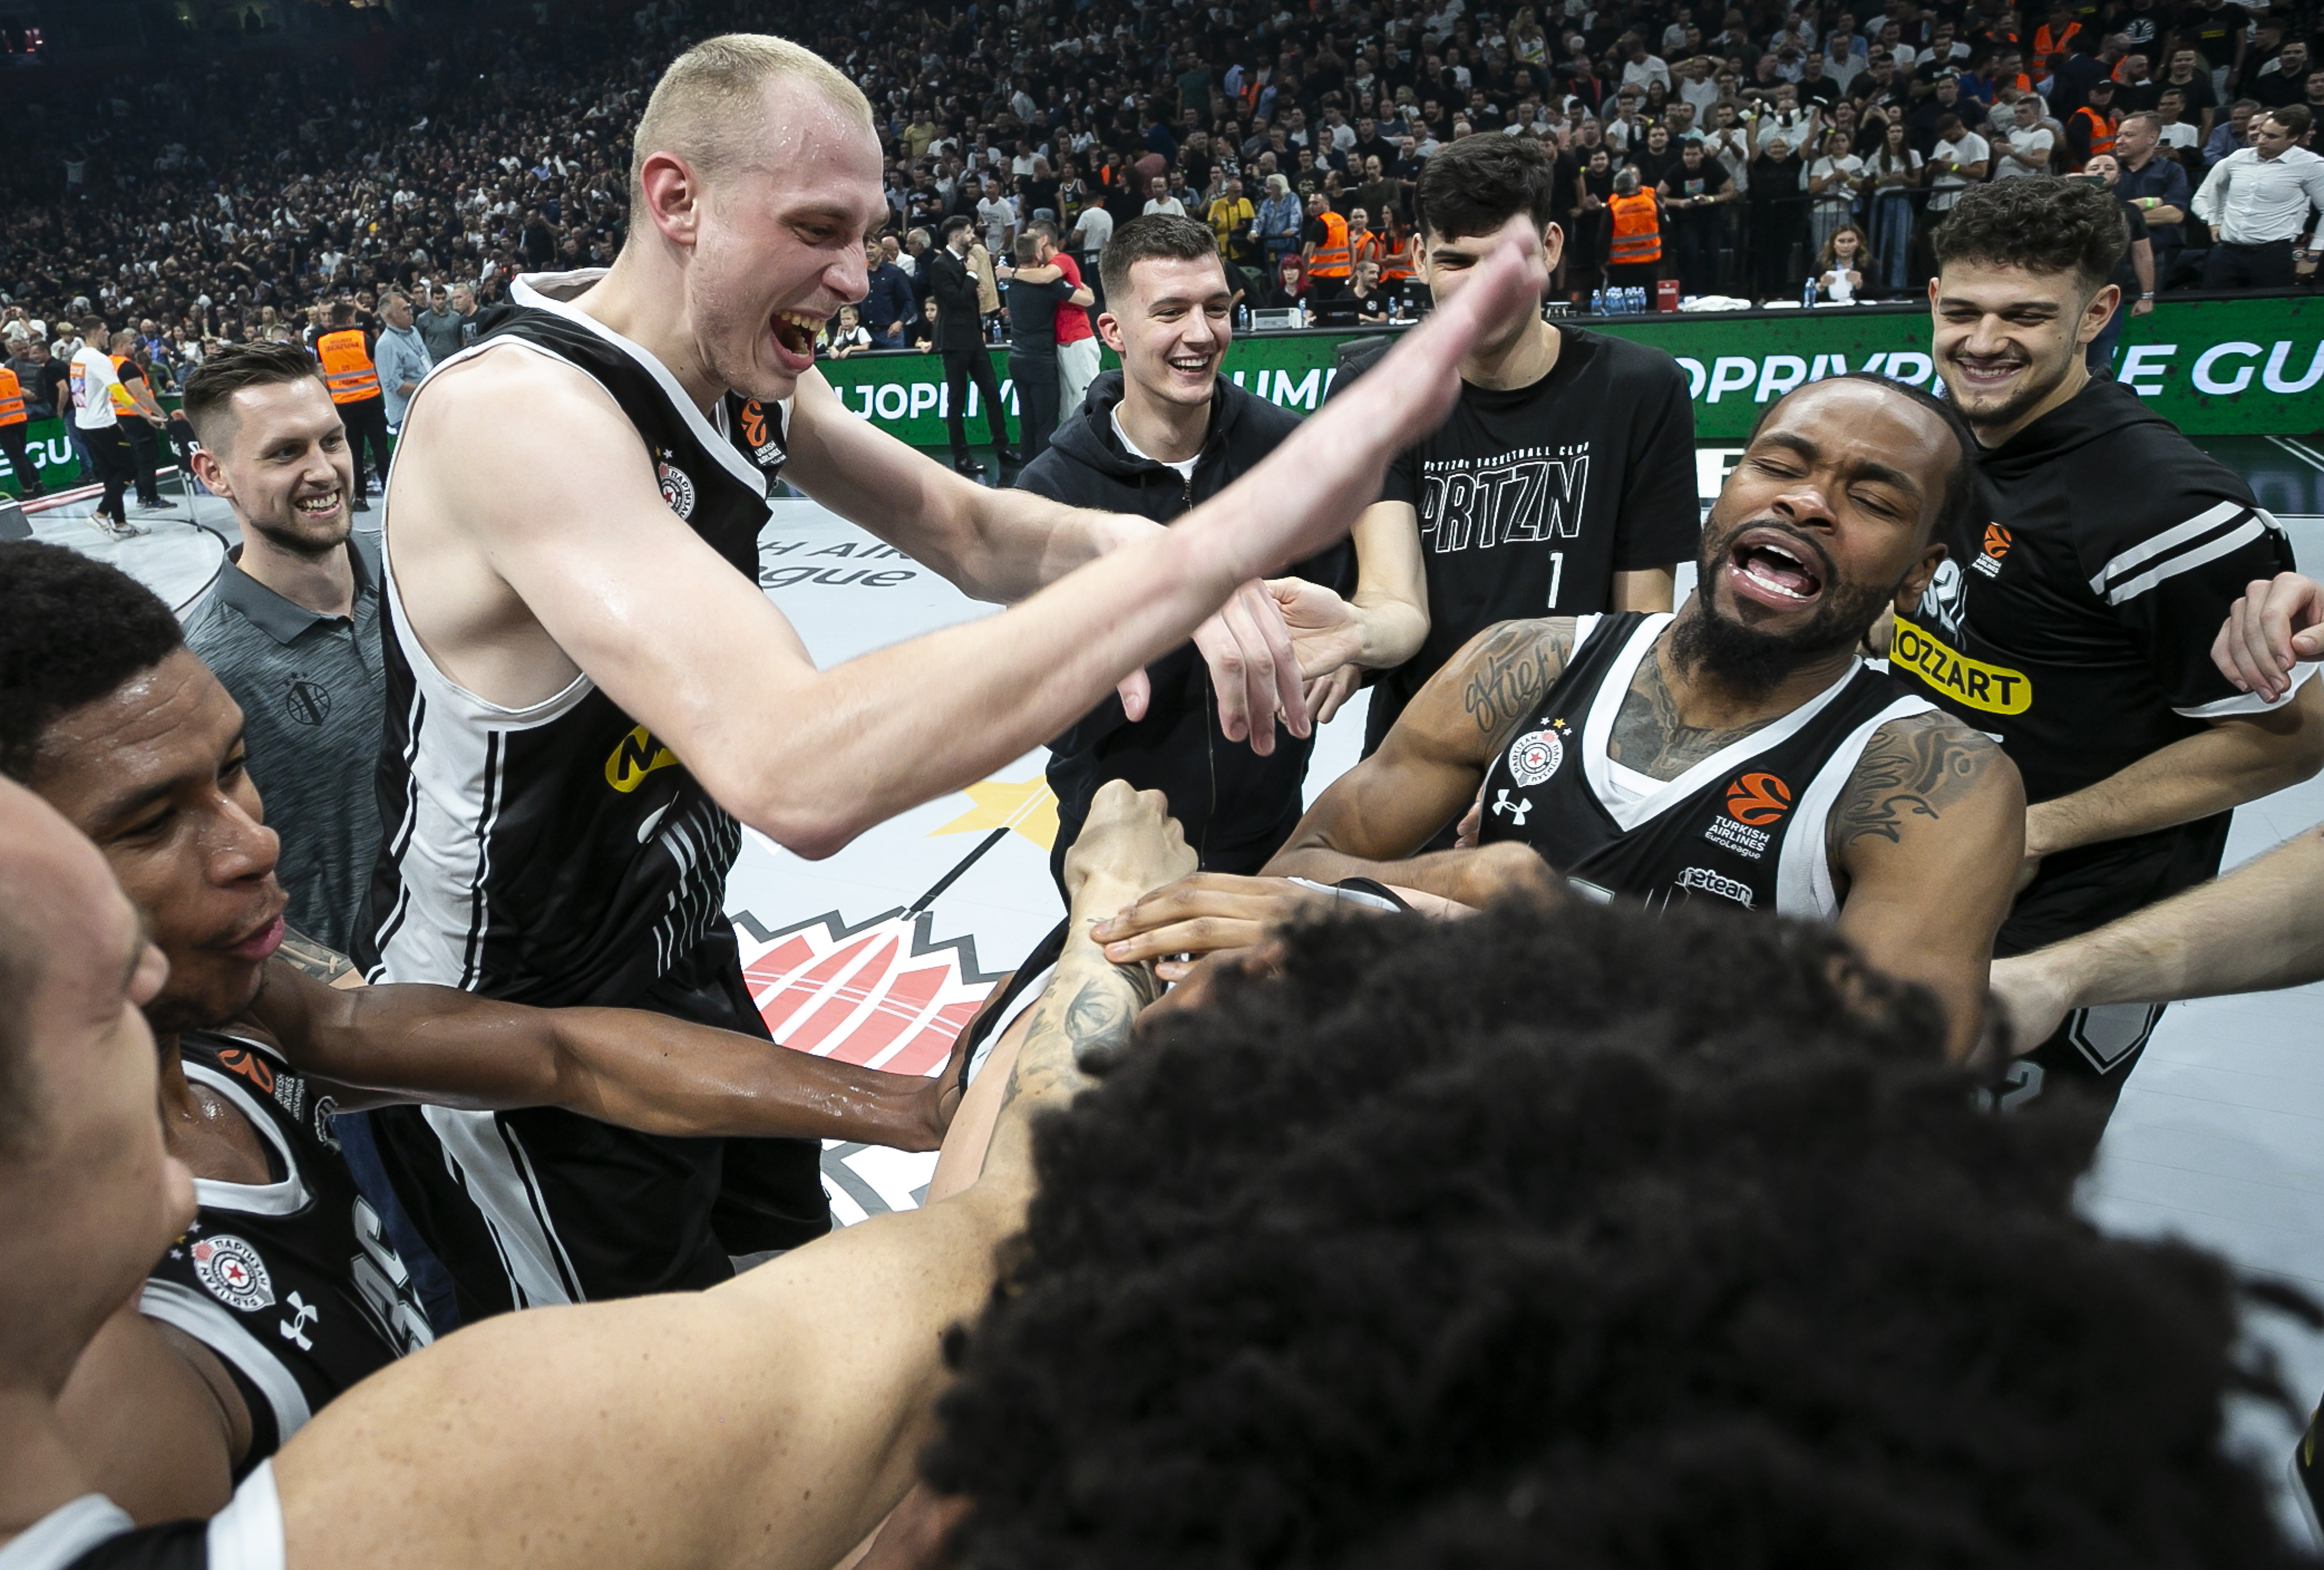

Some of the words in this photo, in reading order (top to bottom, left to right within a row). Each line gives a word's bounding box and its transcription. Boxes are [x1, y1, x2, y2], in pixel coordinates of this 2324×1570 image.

[1477, 446, 1550, 468] BASKETBALL
[759, 565, 917, 589] gue
[1547, 551, 1563, 608] 1
[1708, 824, 1766, 852] AIRLINES
[1715, 815, 1770, 843] TURKISH
[1704, 831, 1761, 859] EuroLeague
